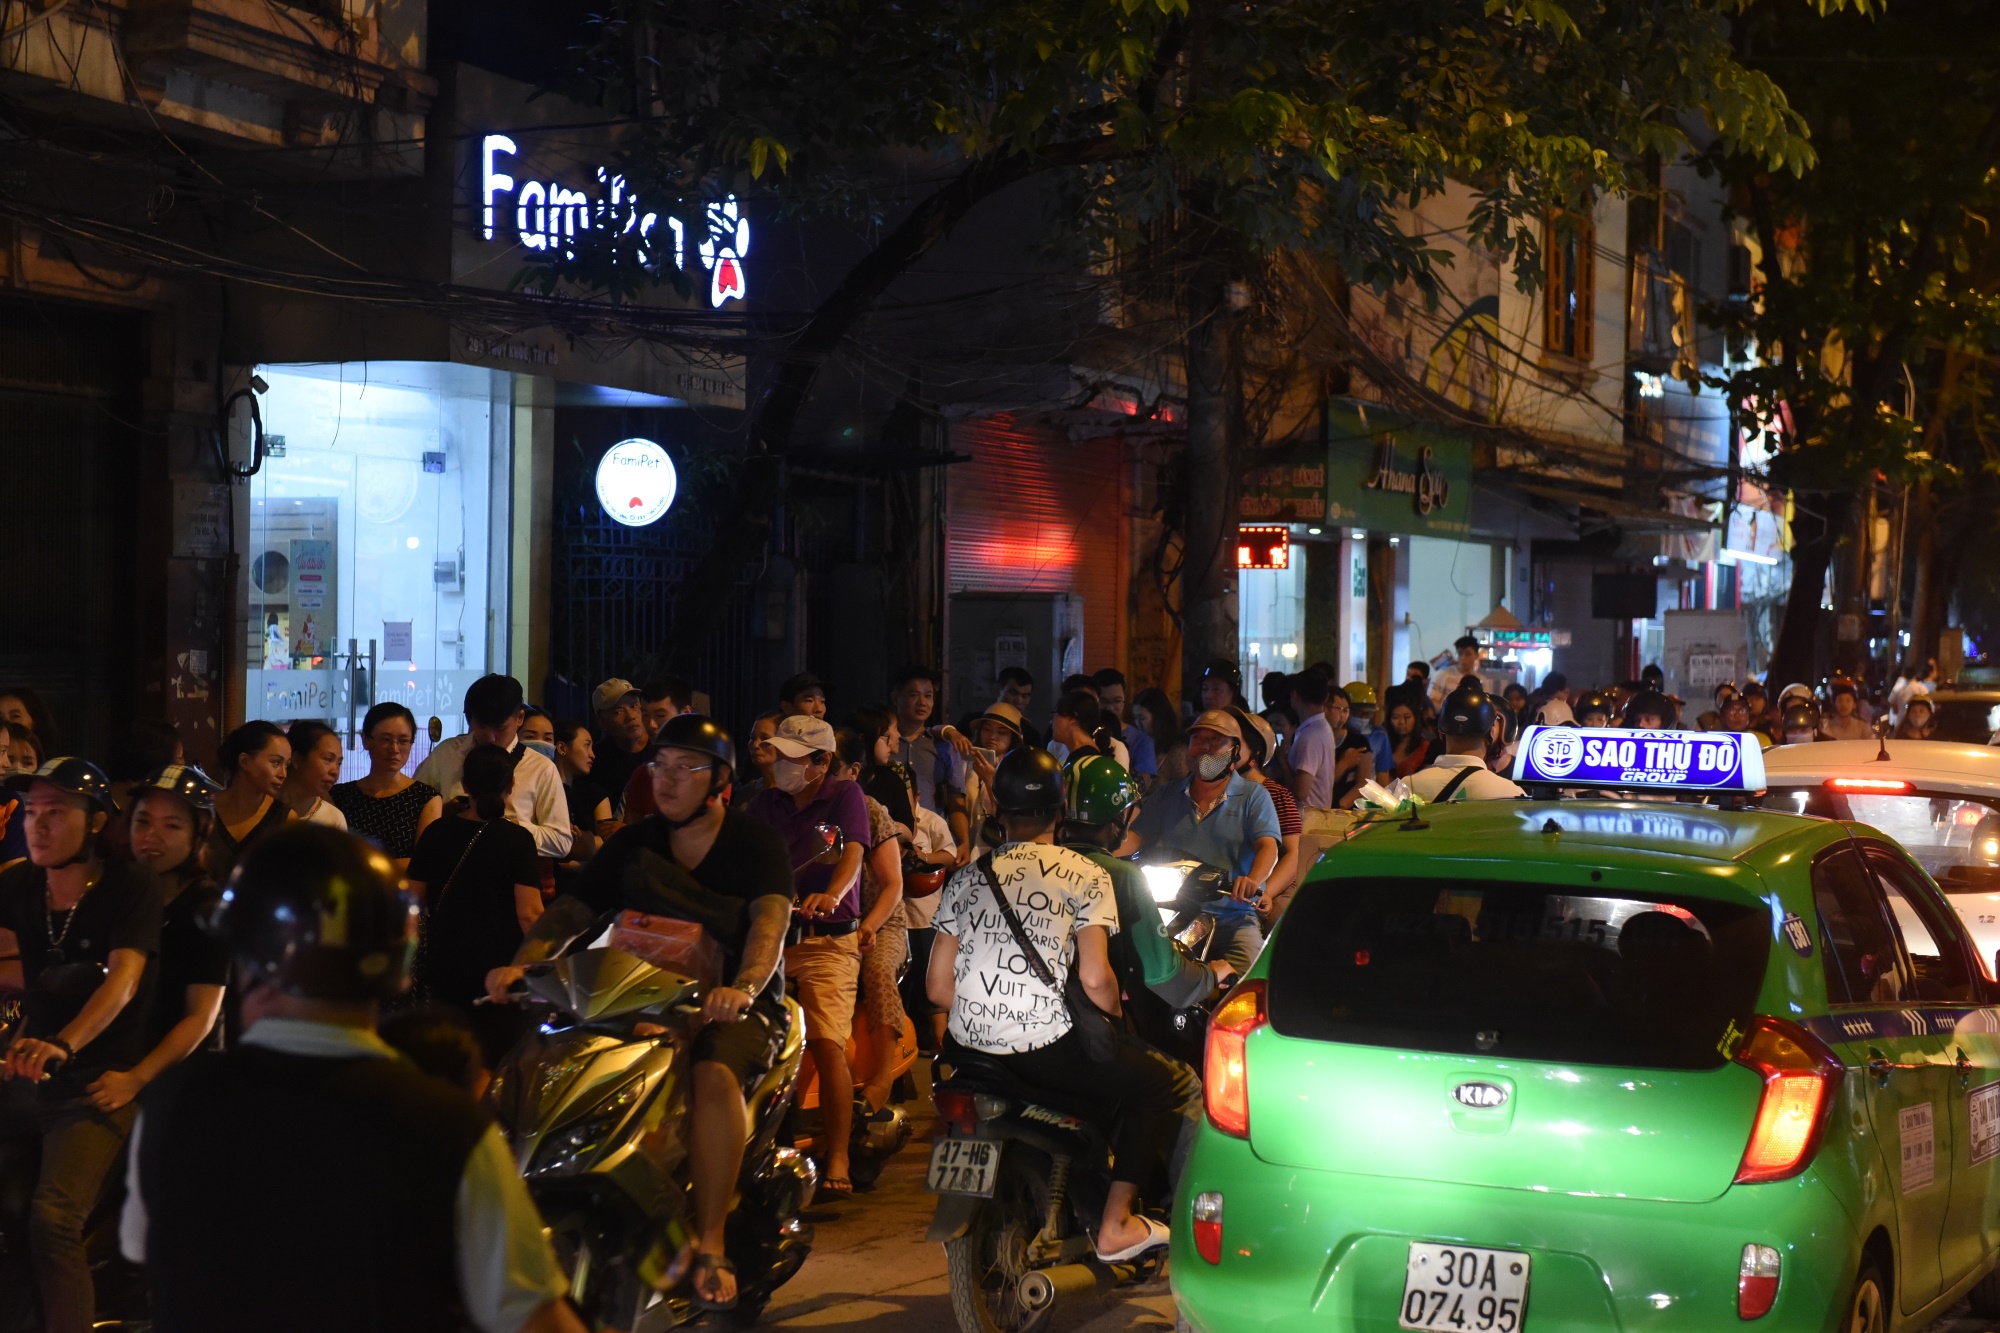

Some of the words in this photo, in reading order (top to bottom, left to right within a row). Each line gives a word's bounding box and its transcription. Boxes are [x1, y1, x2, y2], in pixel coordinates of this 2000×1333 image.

[612, 452, 660, 468] FamiPet
[266, 681, 337, 711] FamiPet
[375, 681, 432, 706] amiPet
[1584, 740, 1637, 767] SAO
[1644, 740, 1693, 770] THỦ
[1698, 742, 1735, 772] ĐÔ
[1620, 772, 1687, 783] GROUP
[1039, 859, 1084, 886] VUIT
[1016, 886, 1078, 918] LOUIS
[969, 909, 1007, 932] VUI
[997, 948, 1057, 978] LOUS
[980, 971, 1026, 997] VUIT
[957, 994, 996, 1019] TTON
[960, 1015, 992, 1036] VUIT
[1460, 1085, 1500, 1105] KIA
[1436, 1250, 1497, 1291] 30A
[1404, 1289, 1520, 1333] 074.95
